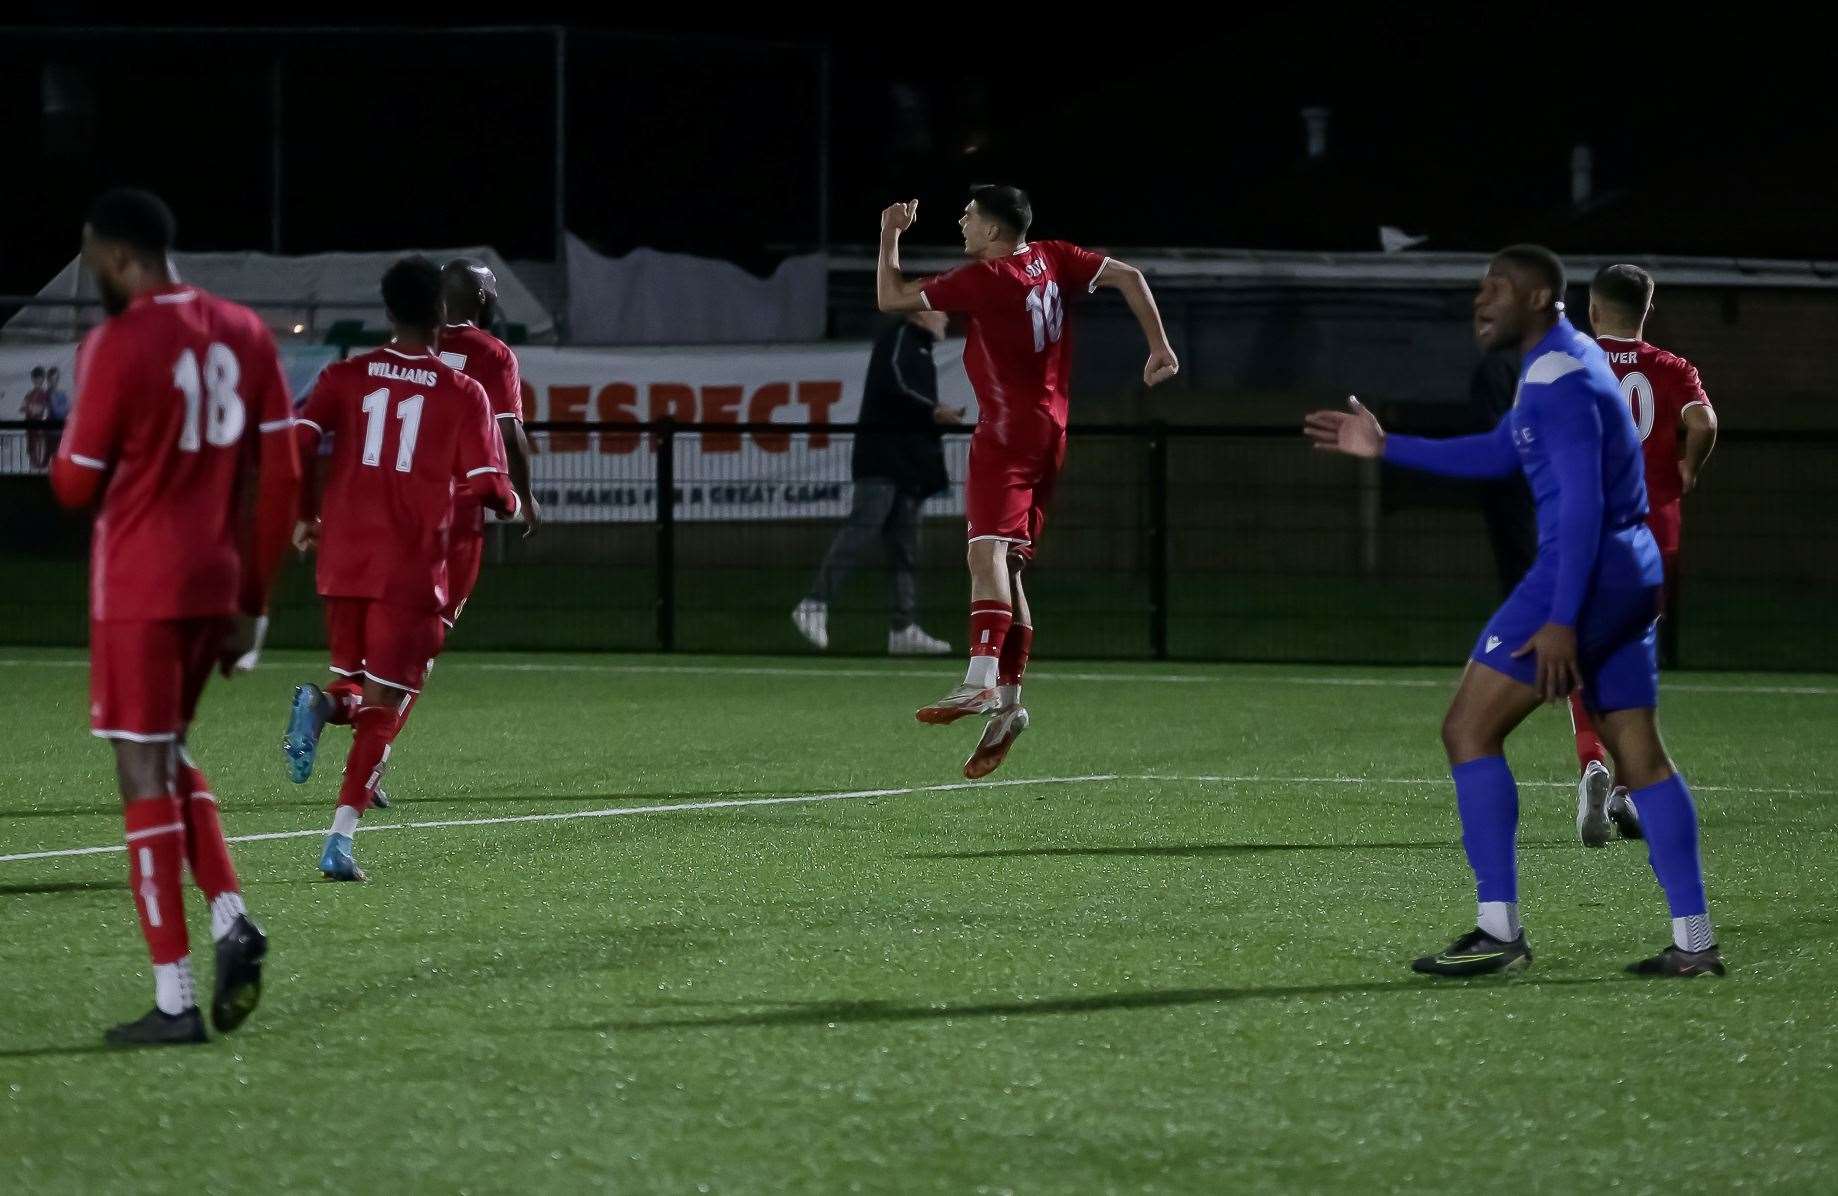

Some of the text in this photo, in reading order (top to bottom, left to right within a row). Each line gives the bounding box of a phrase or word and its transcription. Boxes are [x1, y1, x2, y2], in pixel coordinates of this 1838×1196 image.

[368, 362, 438, 388] WILLIAMS
[1606, 352, 1638, 364] IVER
[173, 342, 246, 453] 18
[1618, 371, 1655, 442] 0
[362, 387, 425, 473] 11
[644, 488, 684, 506] FR
[709, 485, 773, 504] GREAT
